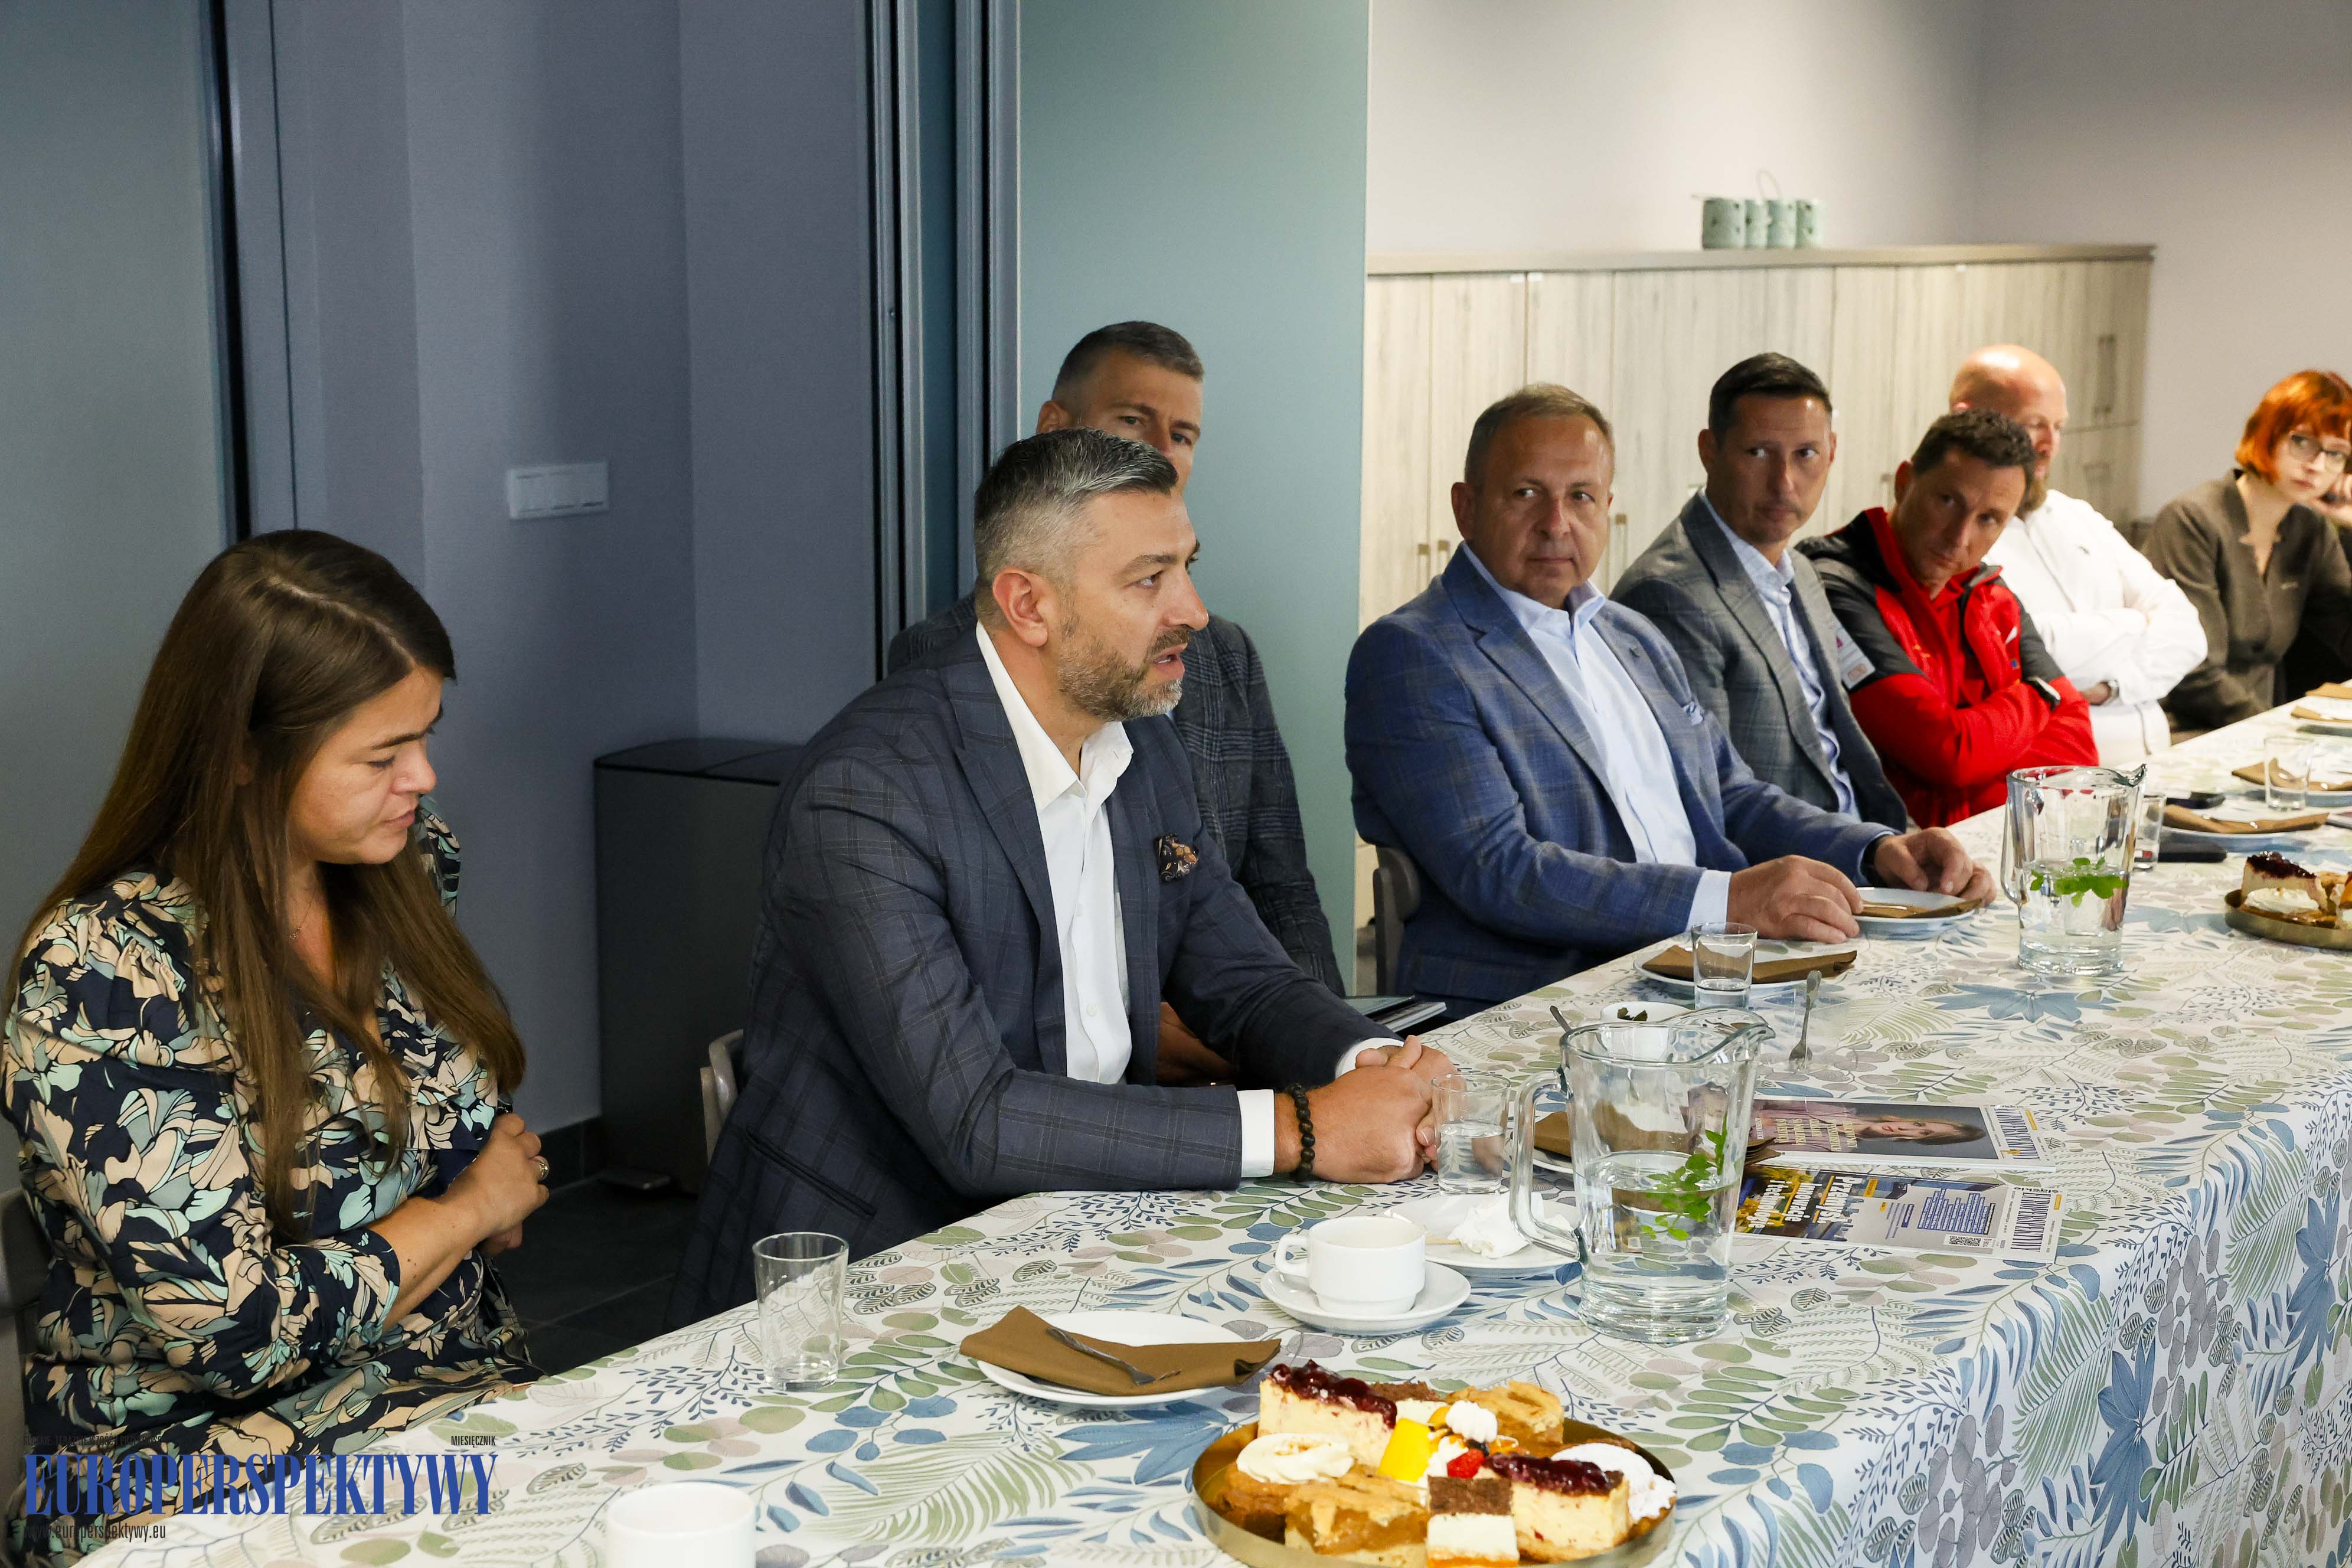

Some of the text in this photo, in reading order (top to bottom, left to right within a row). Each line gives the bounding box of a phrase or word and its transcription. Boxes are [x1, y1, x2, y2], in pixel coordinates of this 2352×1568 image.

[1746, 1184, 1789, 1229] technologie
[1781, 1182, 1822, 1222] Innowacje
[1815, 1176, 1863, 1224] Przemysł.
[2010, 1192, 2052, 1252] EUROPERSPEKTYWY
